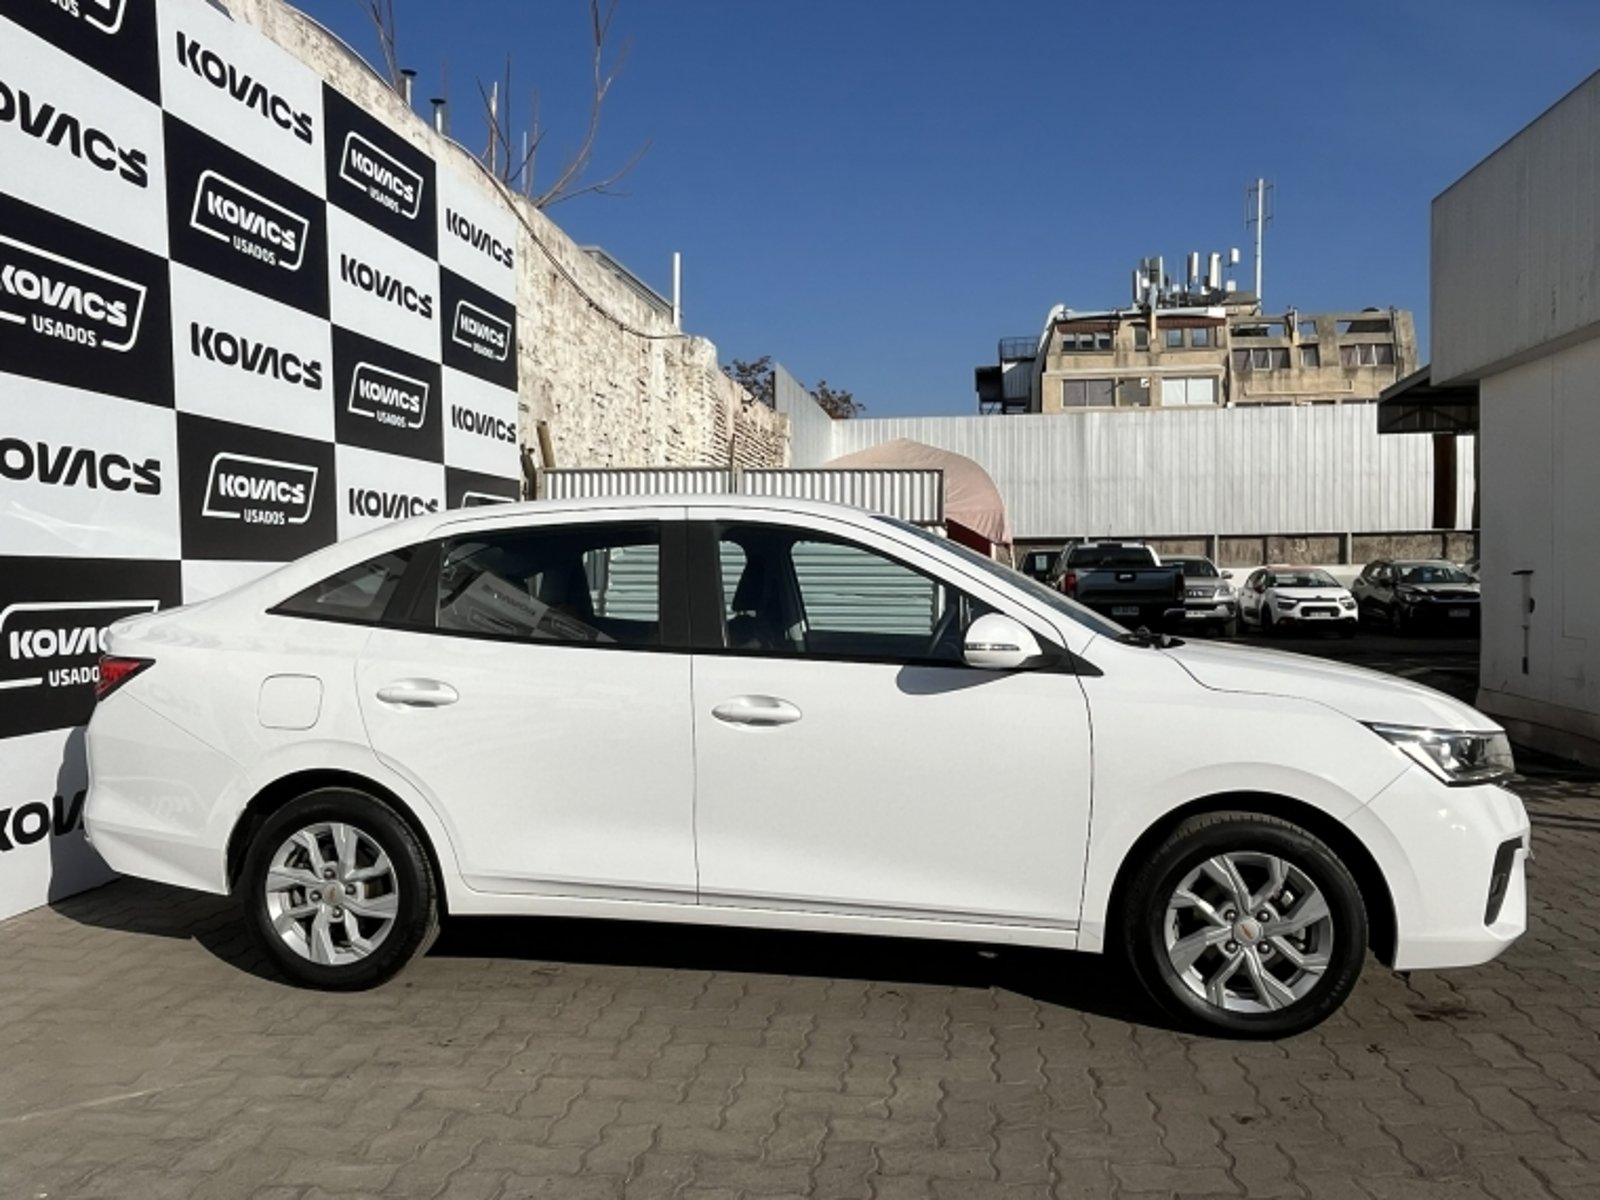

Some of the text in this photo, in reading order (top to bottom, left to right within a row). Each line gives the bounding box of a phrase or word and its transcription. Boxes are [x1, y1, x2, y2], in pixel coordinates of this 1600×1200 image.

[176, 30, 313, 145] KOVACS
[0, 80, 148, 189] VACS
[352, 148, 414, 203] KOVACS
[207, 190, 296, 251] KOVACS
[446, 208, 513, 269] KOVACS
[232, 235, 276, 266] USADOS
[340, 253, 433, 319] KOVACS
[32, 313, 97, 347] USADOS
[190, 321, 323, 390] KOVACS
[359, 378, 420, 413] KOVACS
[451, 404, 516, 443] KOVACS
[0, 437, 161, 496] OVACS
[218, 473, 306, 504] KOVACS
[348, 487, 438, 519] KOVACS
[243, 508, 286, 525] USADOS
[10, 626, 108, 659] KOVA
[48, 665, 100, 687] USADO
